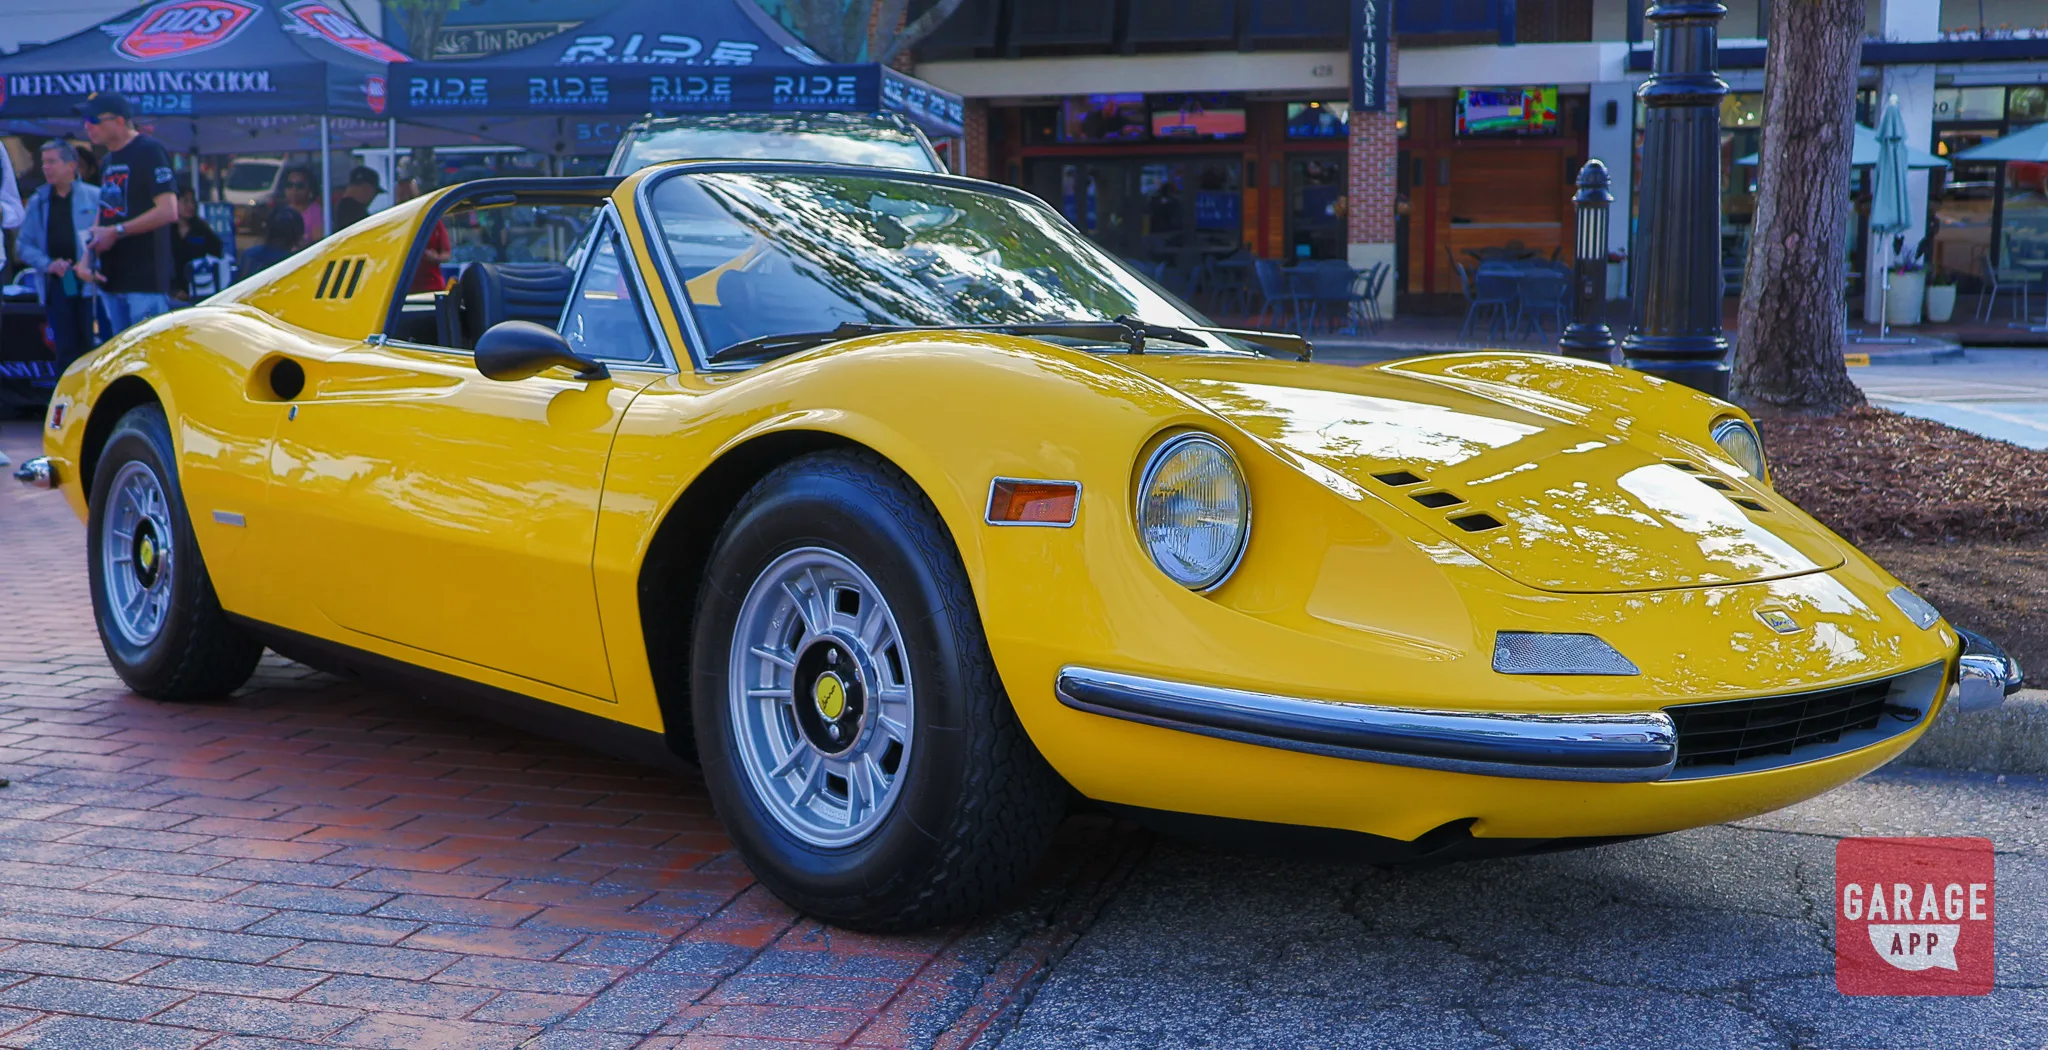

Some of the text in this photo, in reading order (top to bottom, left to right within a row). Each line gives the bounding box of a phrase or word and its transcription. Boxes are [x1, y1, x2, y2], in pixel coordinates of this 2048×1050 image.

[143, 7, 235, 35] DDS
[473, 31, 502, 50] TIN
[565, 34, 760, 62] RIDE
[1362, 0, 1377, 107] AFT HOUSE
[11, 70, 277, 96] DEFENSIVE DRIVING SCHOOL
[410, 78, 489, 97] RIDE
[528, 77, 609, 96] RIDE
[651, 76, 732, 95] RIDE
[773, 76, 857, 95] RIDE
[142, 94, 192, 109] RIDE
